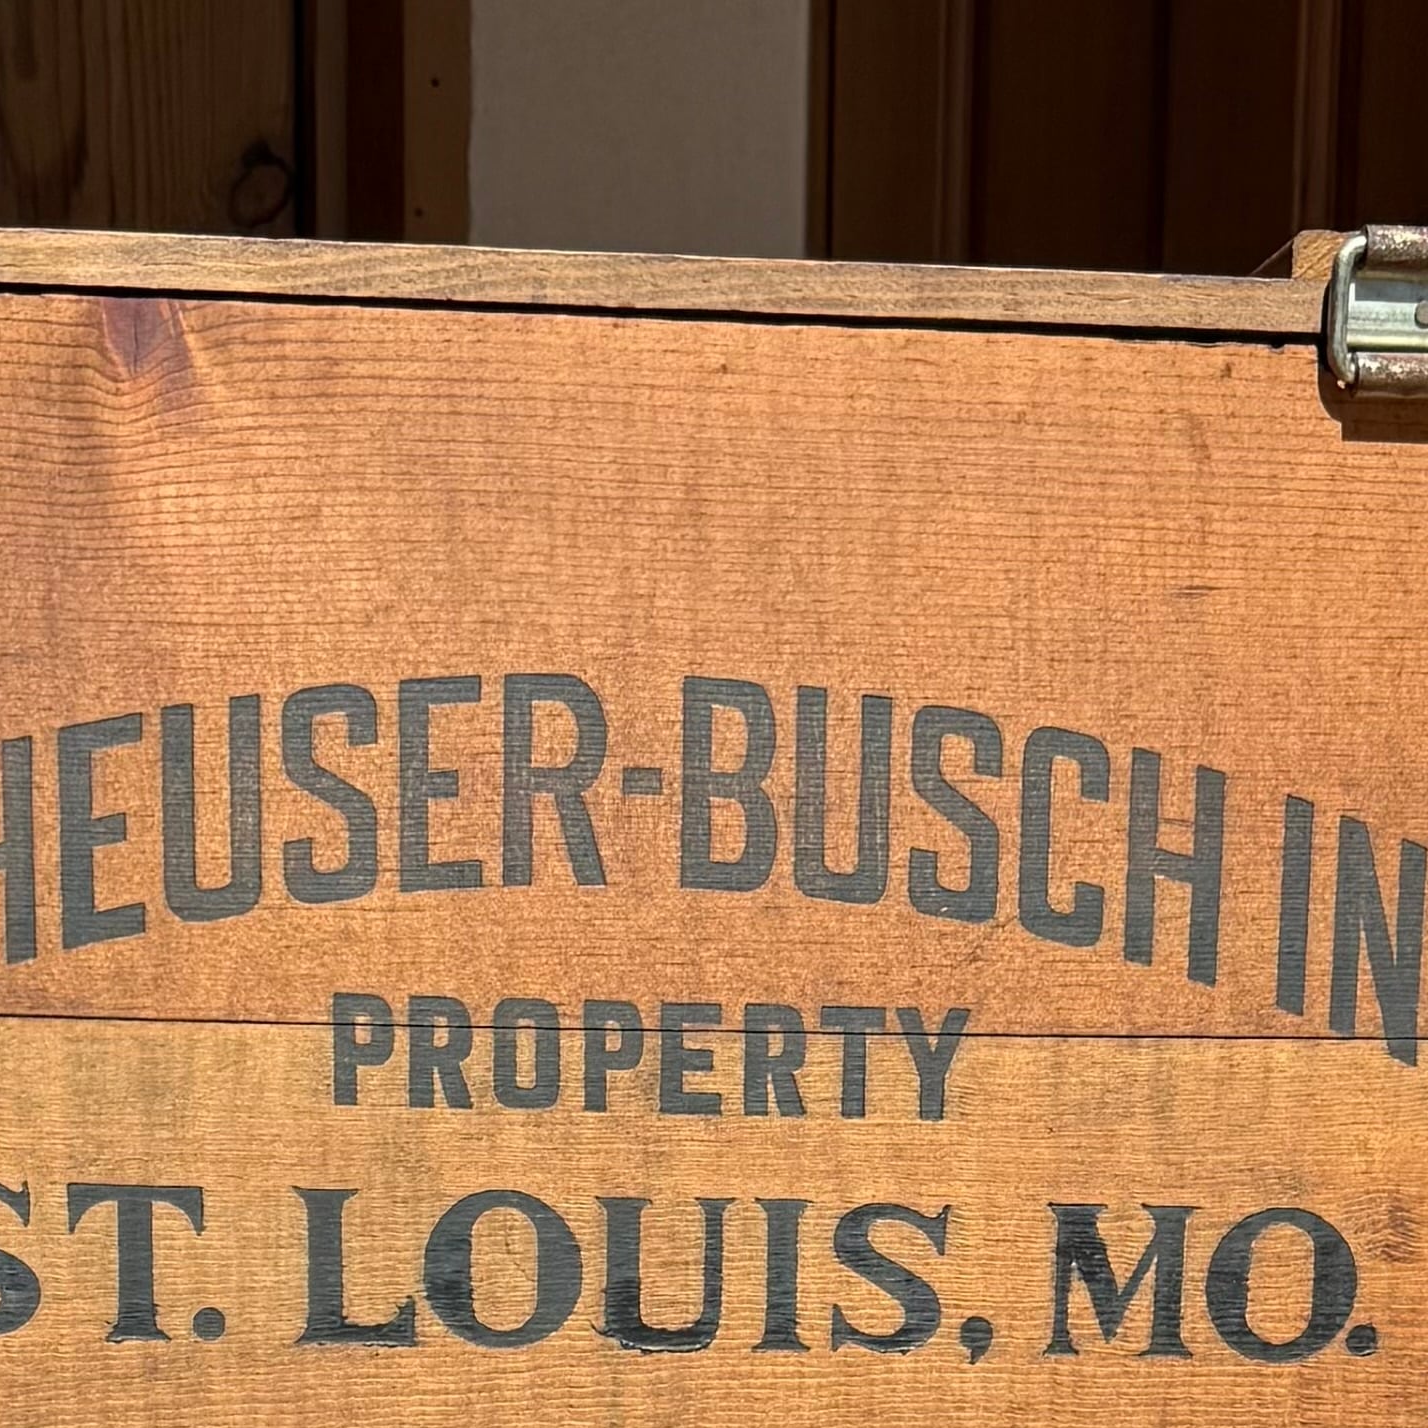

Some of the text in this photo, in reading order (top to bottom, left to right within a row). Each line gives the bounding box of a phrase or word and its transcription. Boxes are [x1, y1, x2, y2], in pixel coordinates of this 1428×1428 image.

[330, 992, 972, 1120] PROPERTY
[295, 1188, 993, 1364] LOUIS,
[1044, 1202, 1380, 1359] MO.
